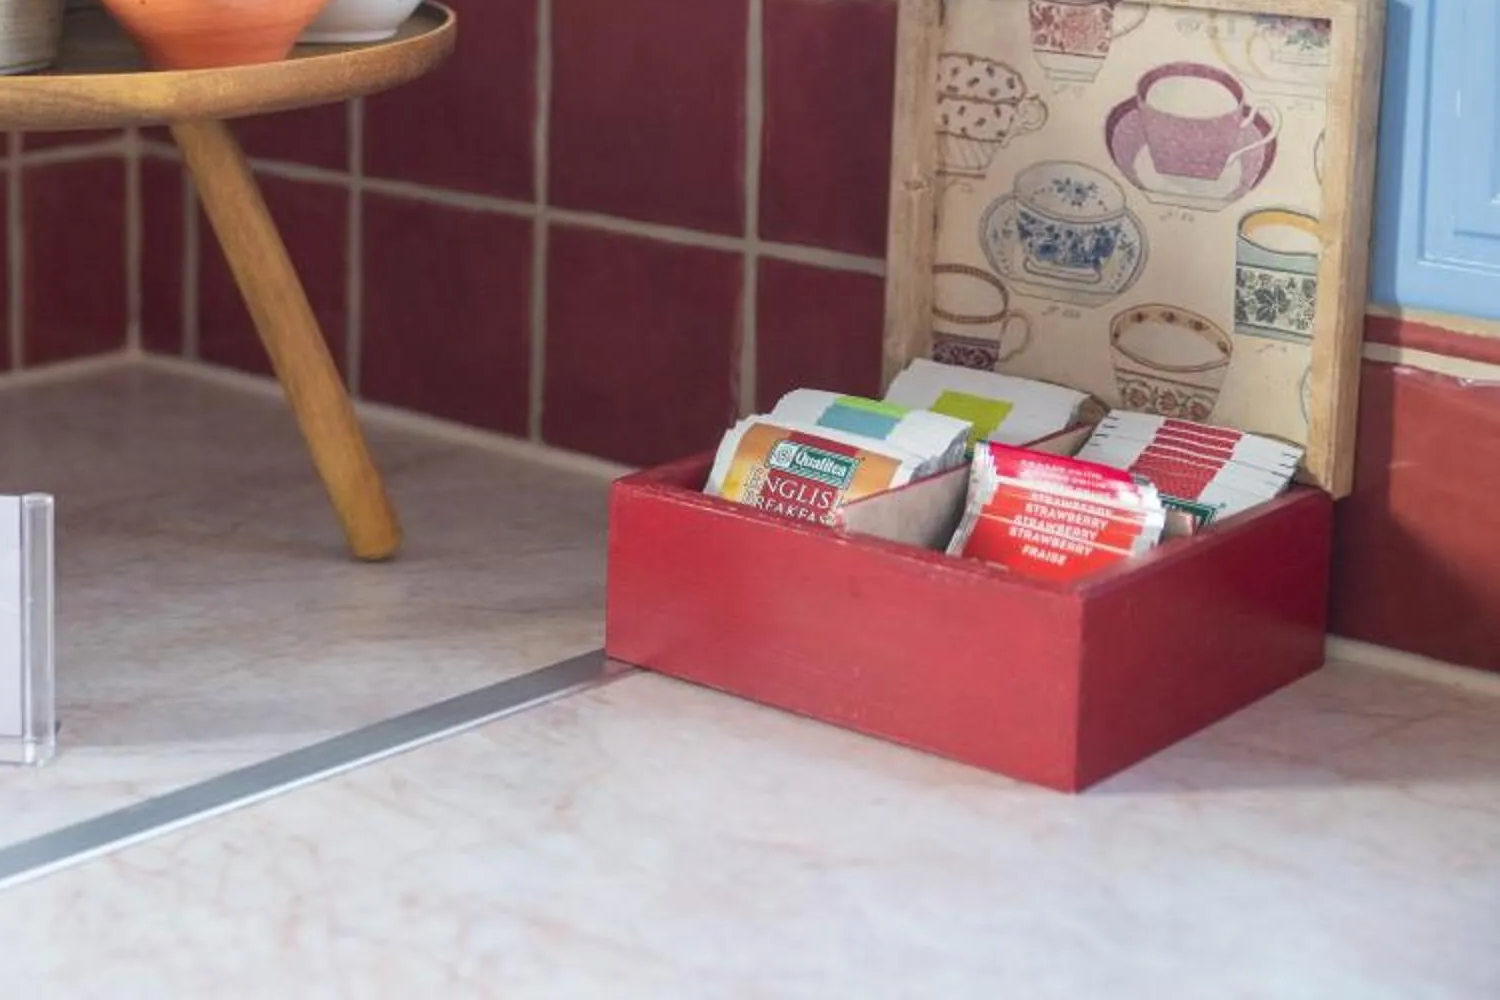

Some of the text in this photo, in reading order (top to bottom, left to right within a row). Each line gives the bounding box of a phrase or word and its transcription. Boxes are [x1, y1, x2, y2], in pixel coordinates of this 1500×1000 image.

[1025, 502, 1109, 531] STRAWBERRY
[1008, 525, 1094, 556] STRAWBERRY
[1021, 544, 1068, 566] FRAISE
